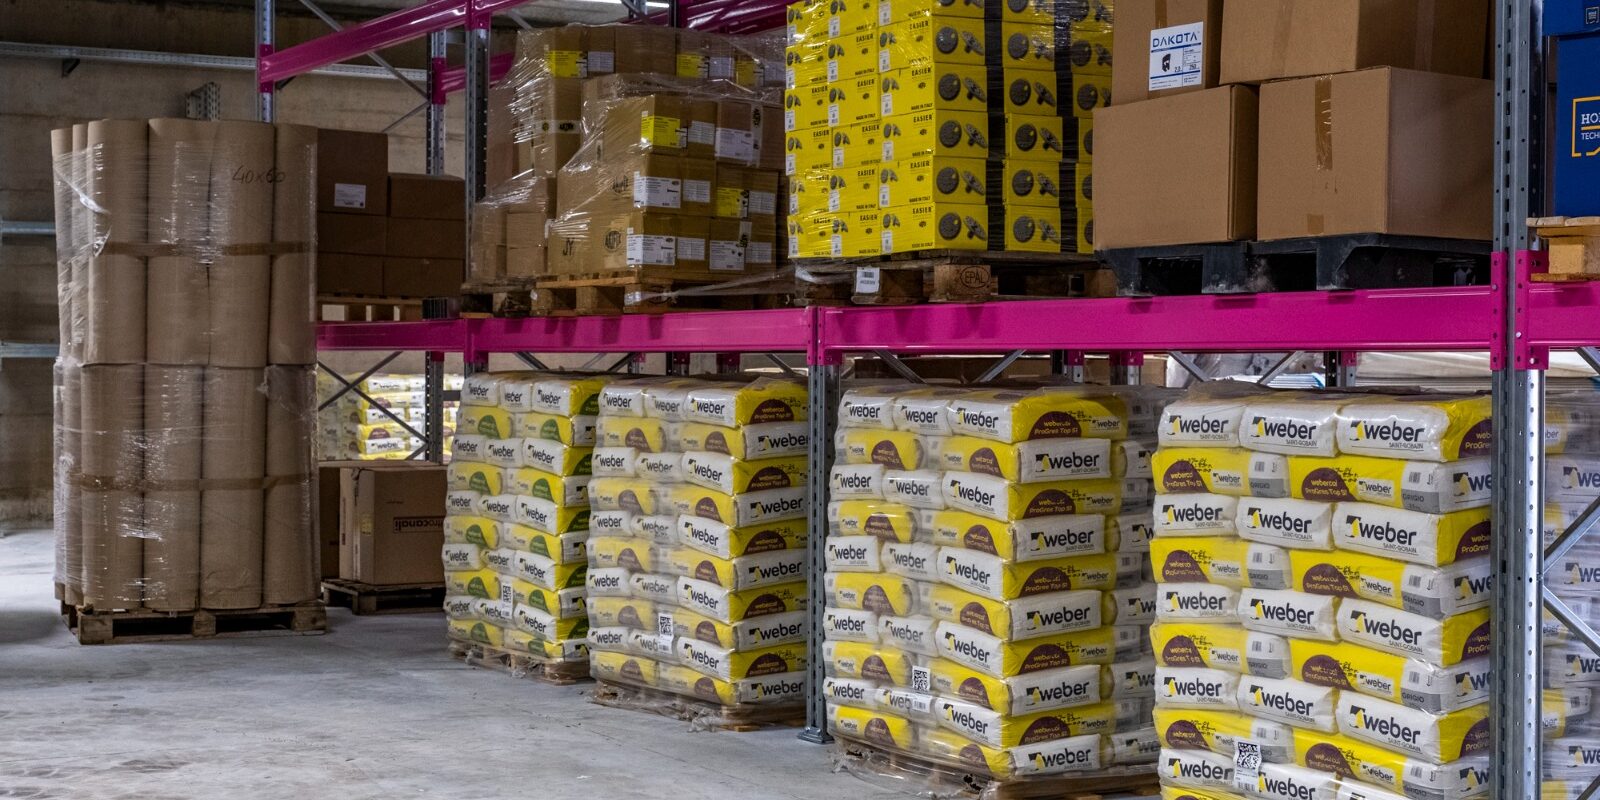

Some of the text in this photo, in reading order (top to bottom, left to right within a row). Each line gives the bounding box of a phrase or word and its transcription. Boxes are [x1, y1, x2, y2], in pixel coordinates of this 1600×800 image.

[1152, 32, 1197, 47] DAKOTA
[1581, 113, 1600, 125] HO
[1581, 132, 1600, 140] TECH
[607, 396, 631, 408] weber
[697, 401, 725, 414] weber
[848, 404, 881, 418] weber
[963, 411, 999, 429] weber
[1179, 416, 1229, 434] weber
[1264, 419, 1317, 441] weber
[1364, 421, 1424, 442] weber
[601, 454, 625, 467] weber
[1050, 454, 1099, 469] weber
[694, 463, 722, 481] weber
[841, 475, 871, 488] weber
[897, 480, 929, 496] weber
[959, 487, 995, 505] weber
[762, 499, 803, 514] weber
[1174, 503, 1223, 520] weber
[597, 516, 622, 528] weber
[1260, 512, 1312, 533] weber
[691, 528, 719, 546] weber
[1044, 529, 1094, 548] weber
[1359, 522, 1417, 545] weber
[836, 546, 867, 559] weber
[894, 552, 926, 568] weber
[760, 562, 802, 577] weber
[955, 561, 990, 583] weber
[595, 575, 619, 587] weber
[691, 591, 719, 609] weber
[1177, 591, 1226, 610] weber
[1040, 606, 1090, 625] weber
[1262, 602, 1314, 625] weber
[760, 623, 802, 639] weber
[835, 618, 865, 631] weber
[891, 625, 923, 641] weber
[1364, 618, 1422, 645] weber
[596, 633, 622, 644] weber
[641, 639, 658, 650] web
[953, 641, 990, 663] weber
[1468, 644, 1490, 653] ProGr
[691, 651, 719, 669] weber
[763, 682, 803, 694] weber
[834, 685, 864, 699] weber
[1040, 681, 1089, 700] weber
[1174, 678, 1222, 697] weber
[890, 693, 911, 707] web
[1261, 690, 1313, 716] weber
[952, 712, 988, 734] weber
[1362, 713, 1420, 744] weber
[1465, 740, 1489, 751] ProGr
[1043, 748, 1091, 766] weber
[1179, 760, 1233, 780] weber
[1264, 777, 1316, 800] weber
